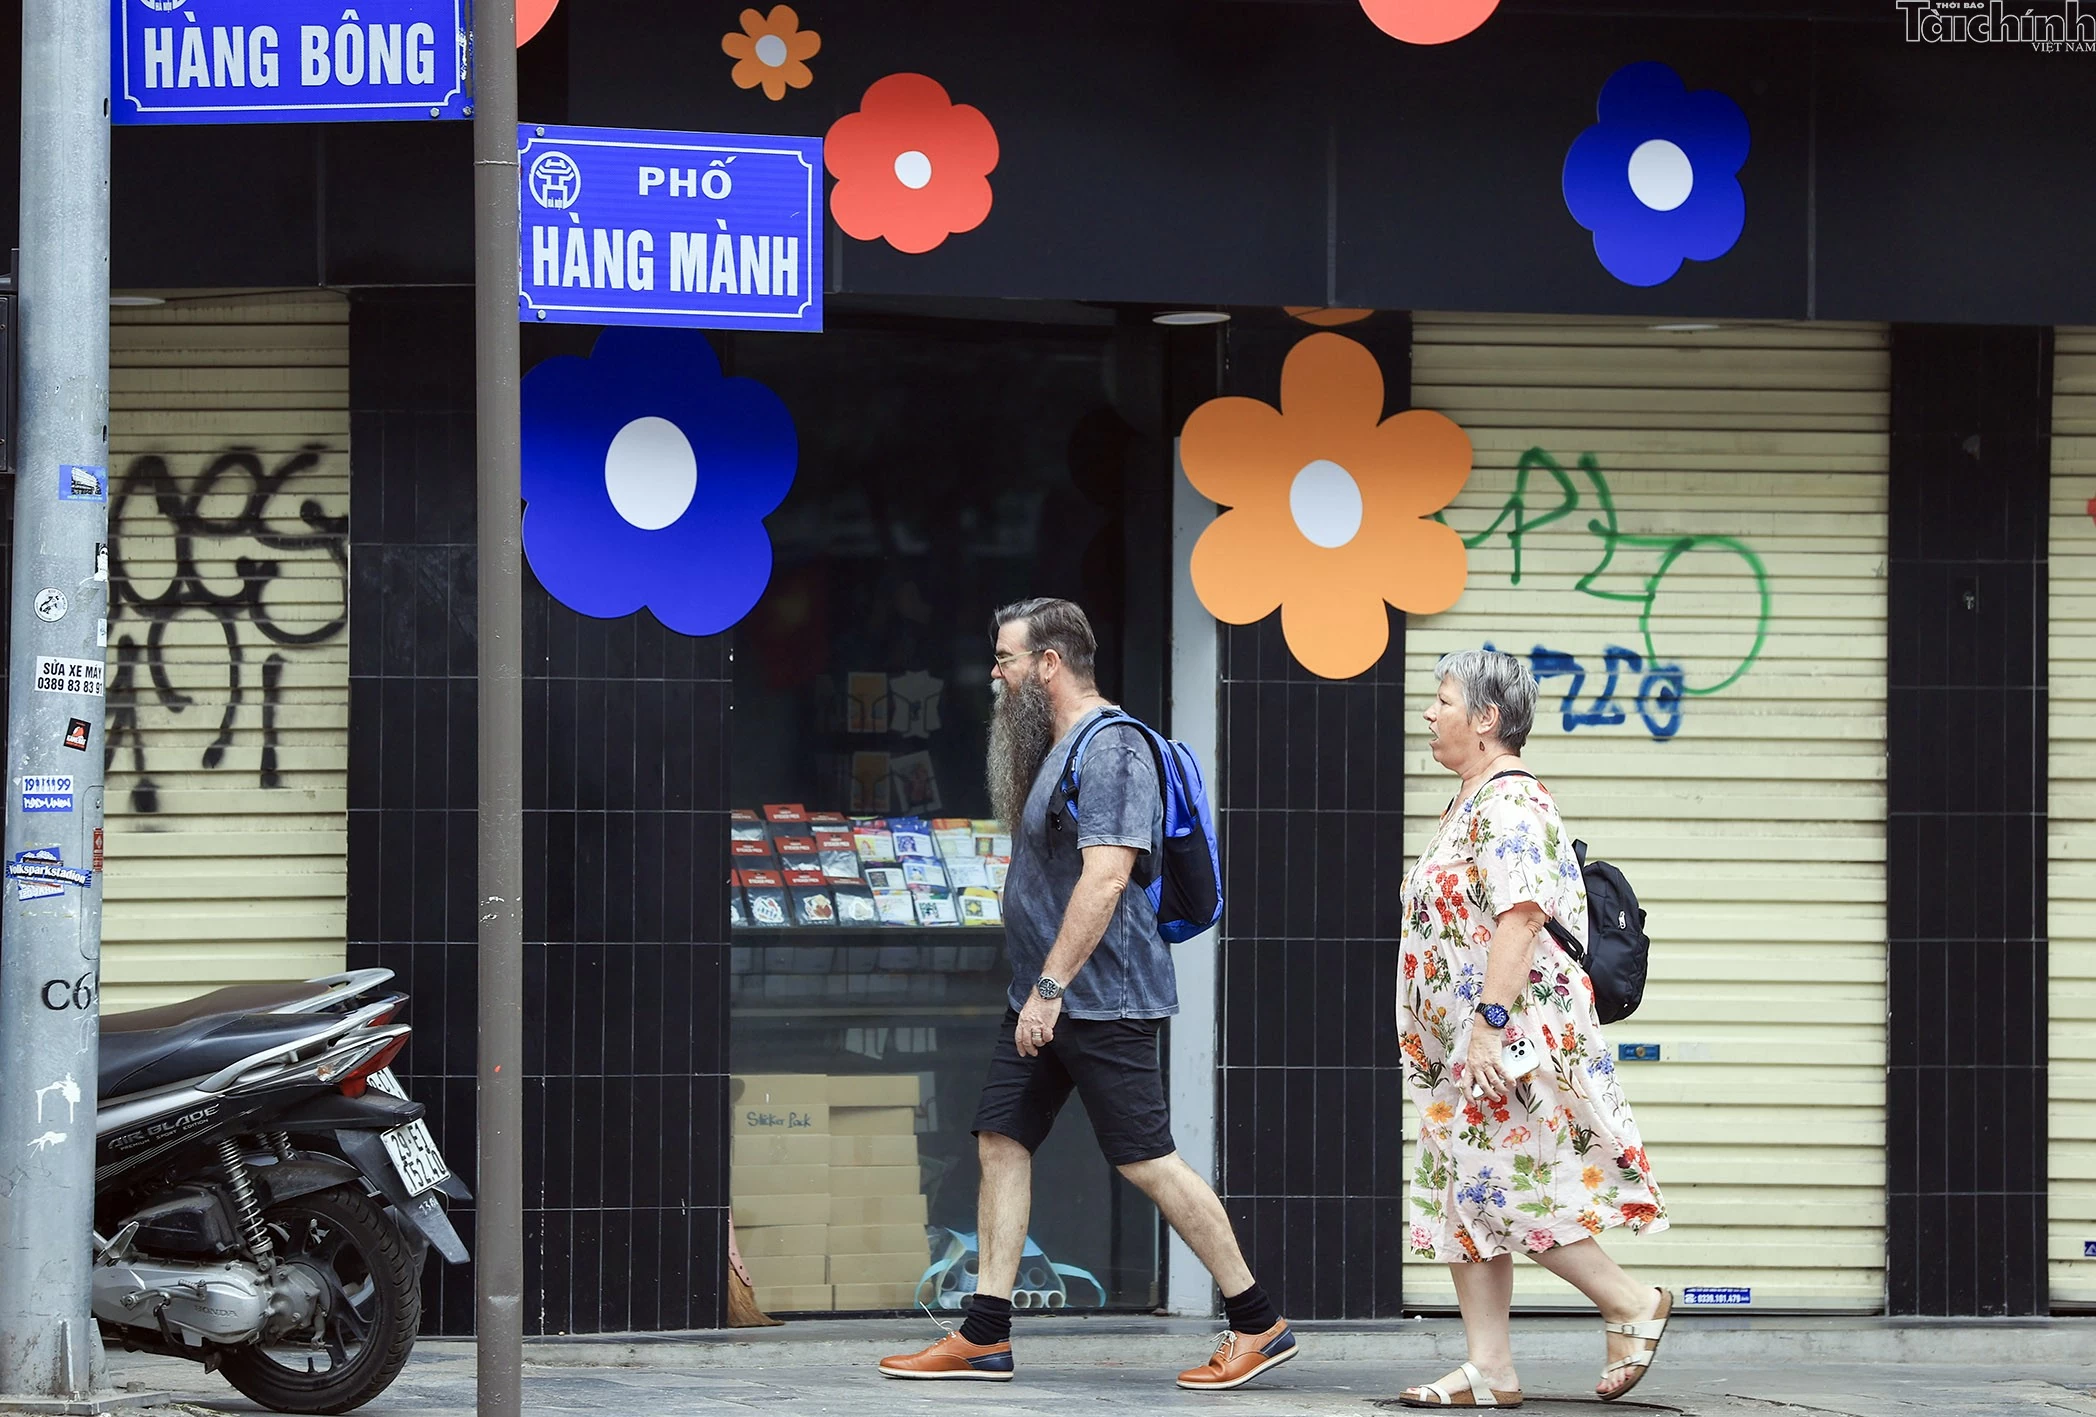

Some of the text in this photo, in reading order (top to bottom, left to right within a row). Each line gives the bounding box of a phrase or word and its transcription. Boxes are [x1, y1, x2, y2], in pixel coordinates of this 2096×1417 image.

[143, 8, 435, 89] HÀNG BÔNG
[638, 155, 738, 200] PHỐ
[531, 211, 799, 297] HÀNG MÀNH
[37, 676, 65, 691] 0389
[67, 679, 81, 692] 83
[83, 680, 94, 694] 83
[43, 658, 102, 680] SỬA XE MÁY
[107, 1103, 220, 1150] AIR BLADE
[120, 1118, 209, 1151] PREMIUM SPORT EDITION
[787, 1111, 812, 1129] Pack
[391, 1122, 428, 1161] 29-E1
